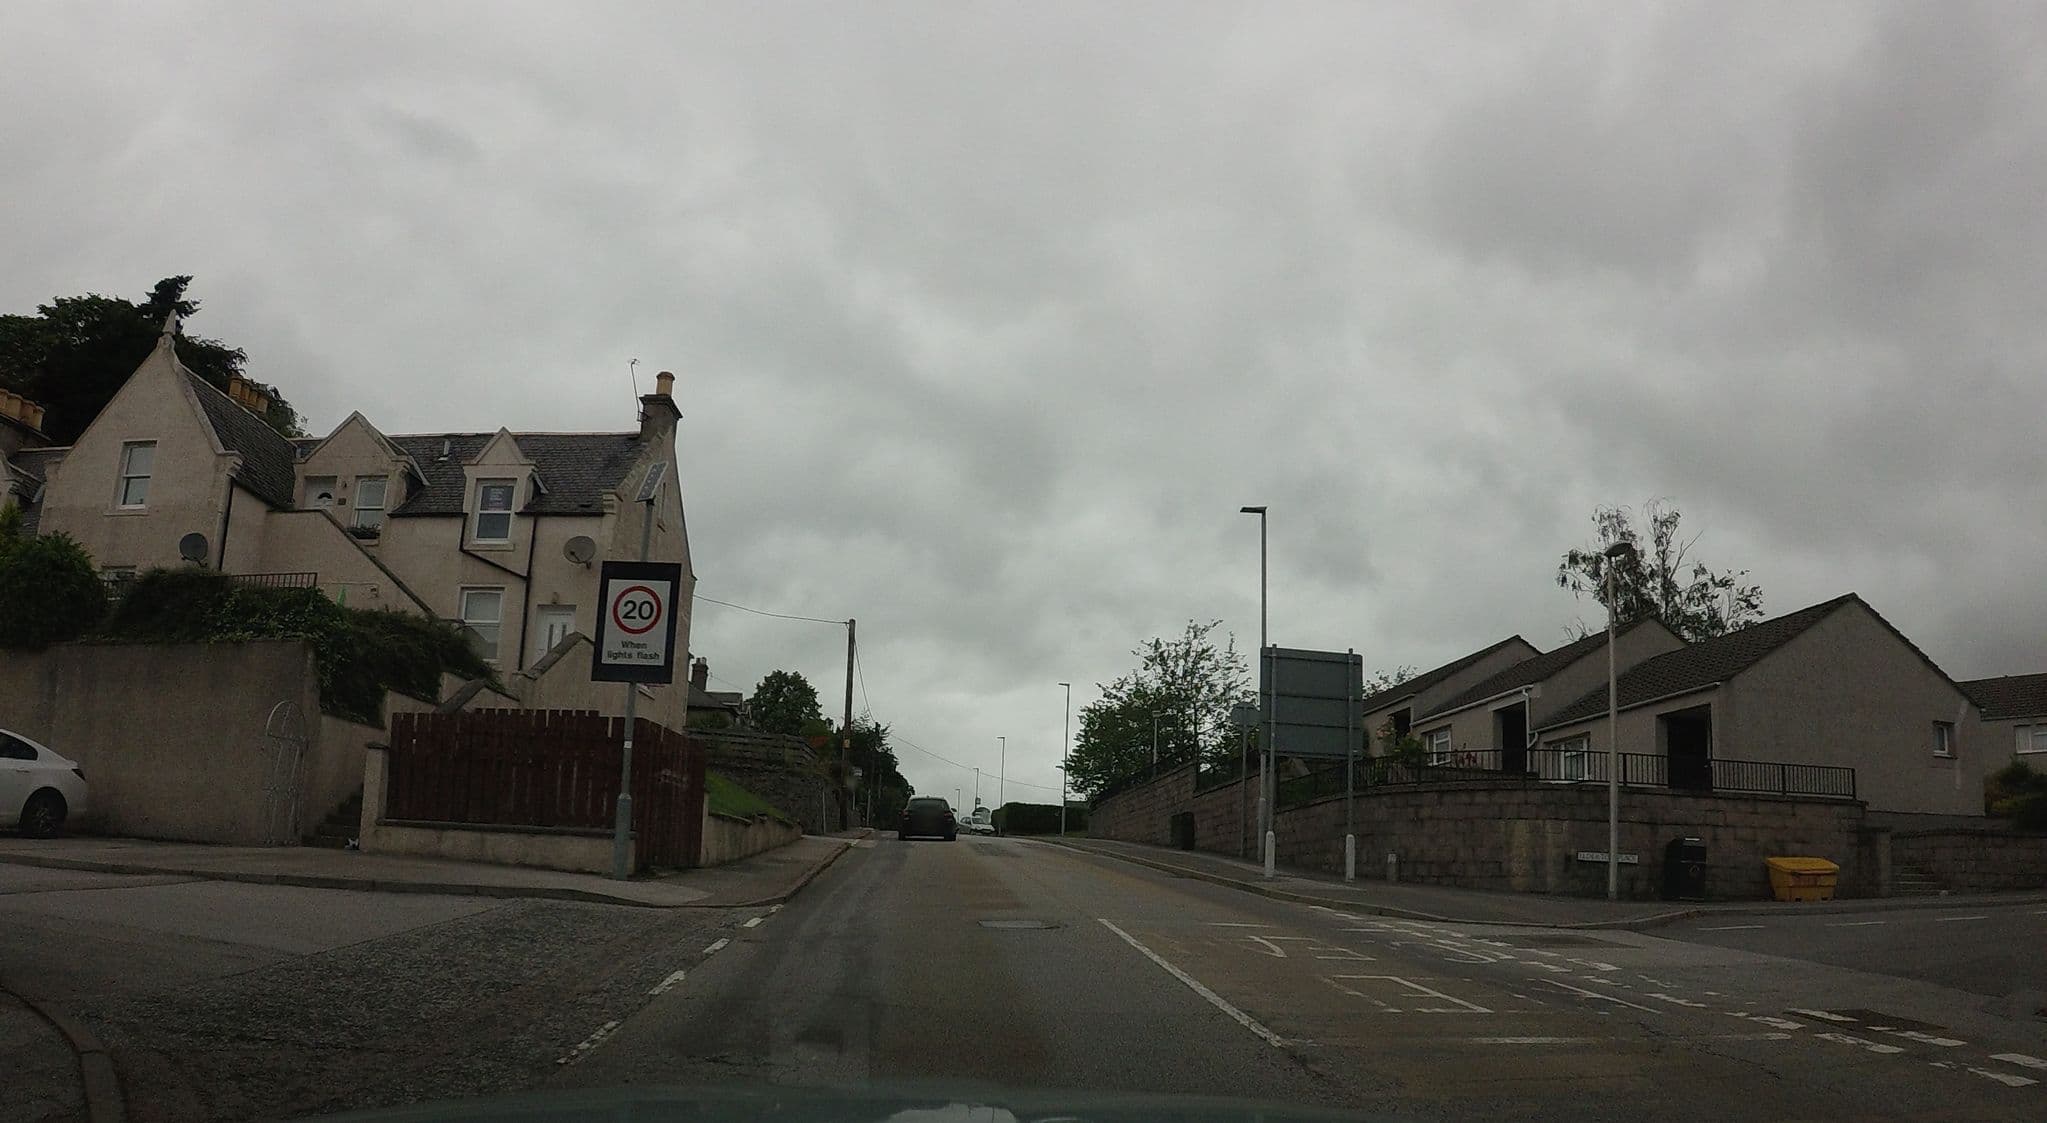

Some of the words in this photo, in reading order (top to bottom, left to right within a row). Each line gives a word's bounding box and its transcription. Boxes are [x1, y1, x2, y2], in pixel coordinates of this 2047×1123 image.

[622, 600, 654, 619] 20
[621, 641, 648, 649] When
[607, 650, 633, 660] lights
[636, 650, 660, 660] flash
